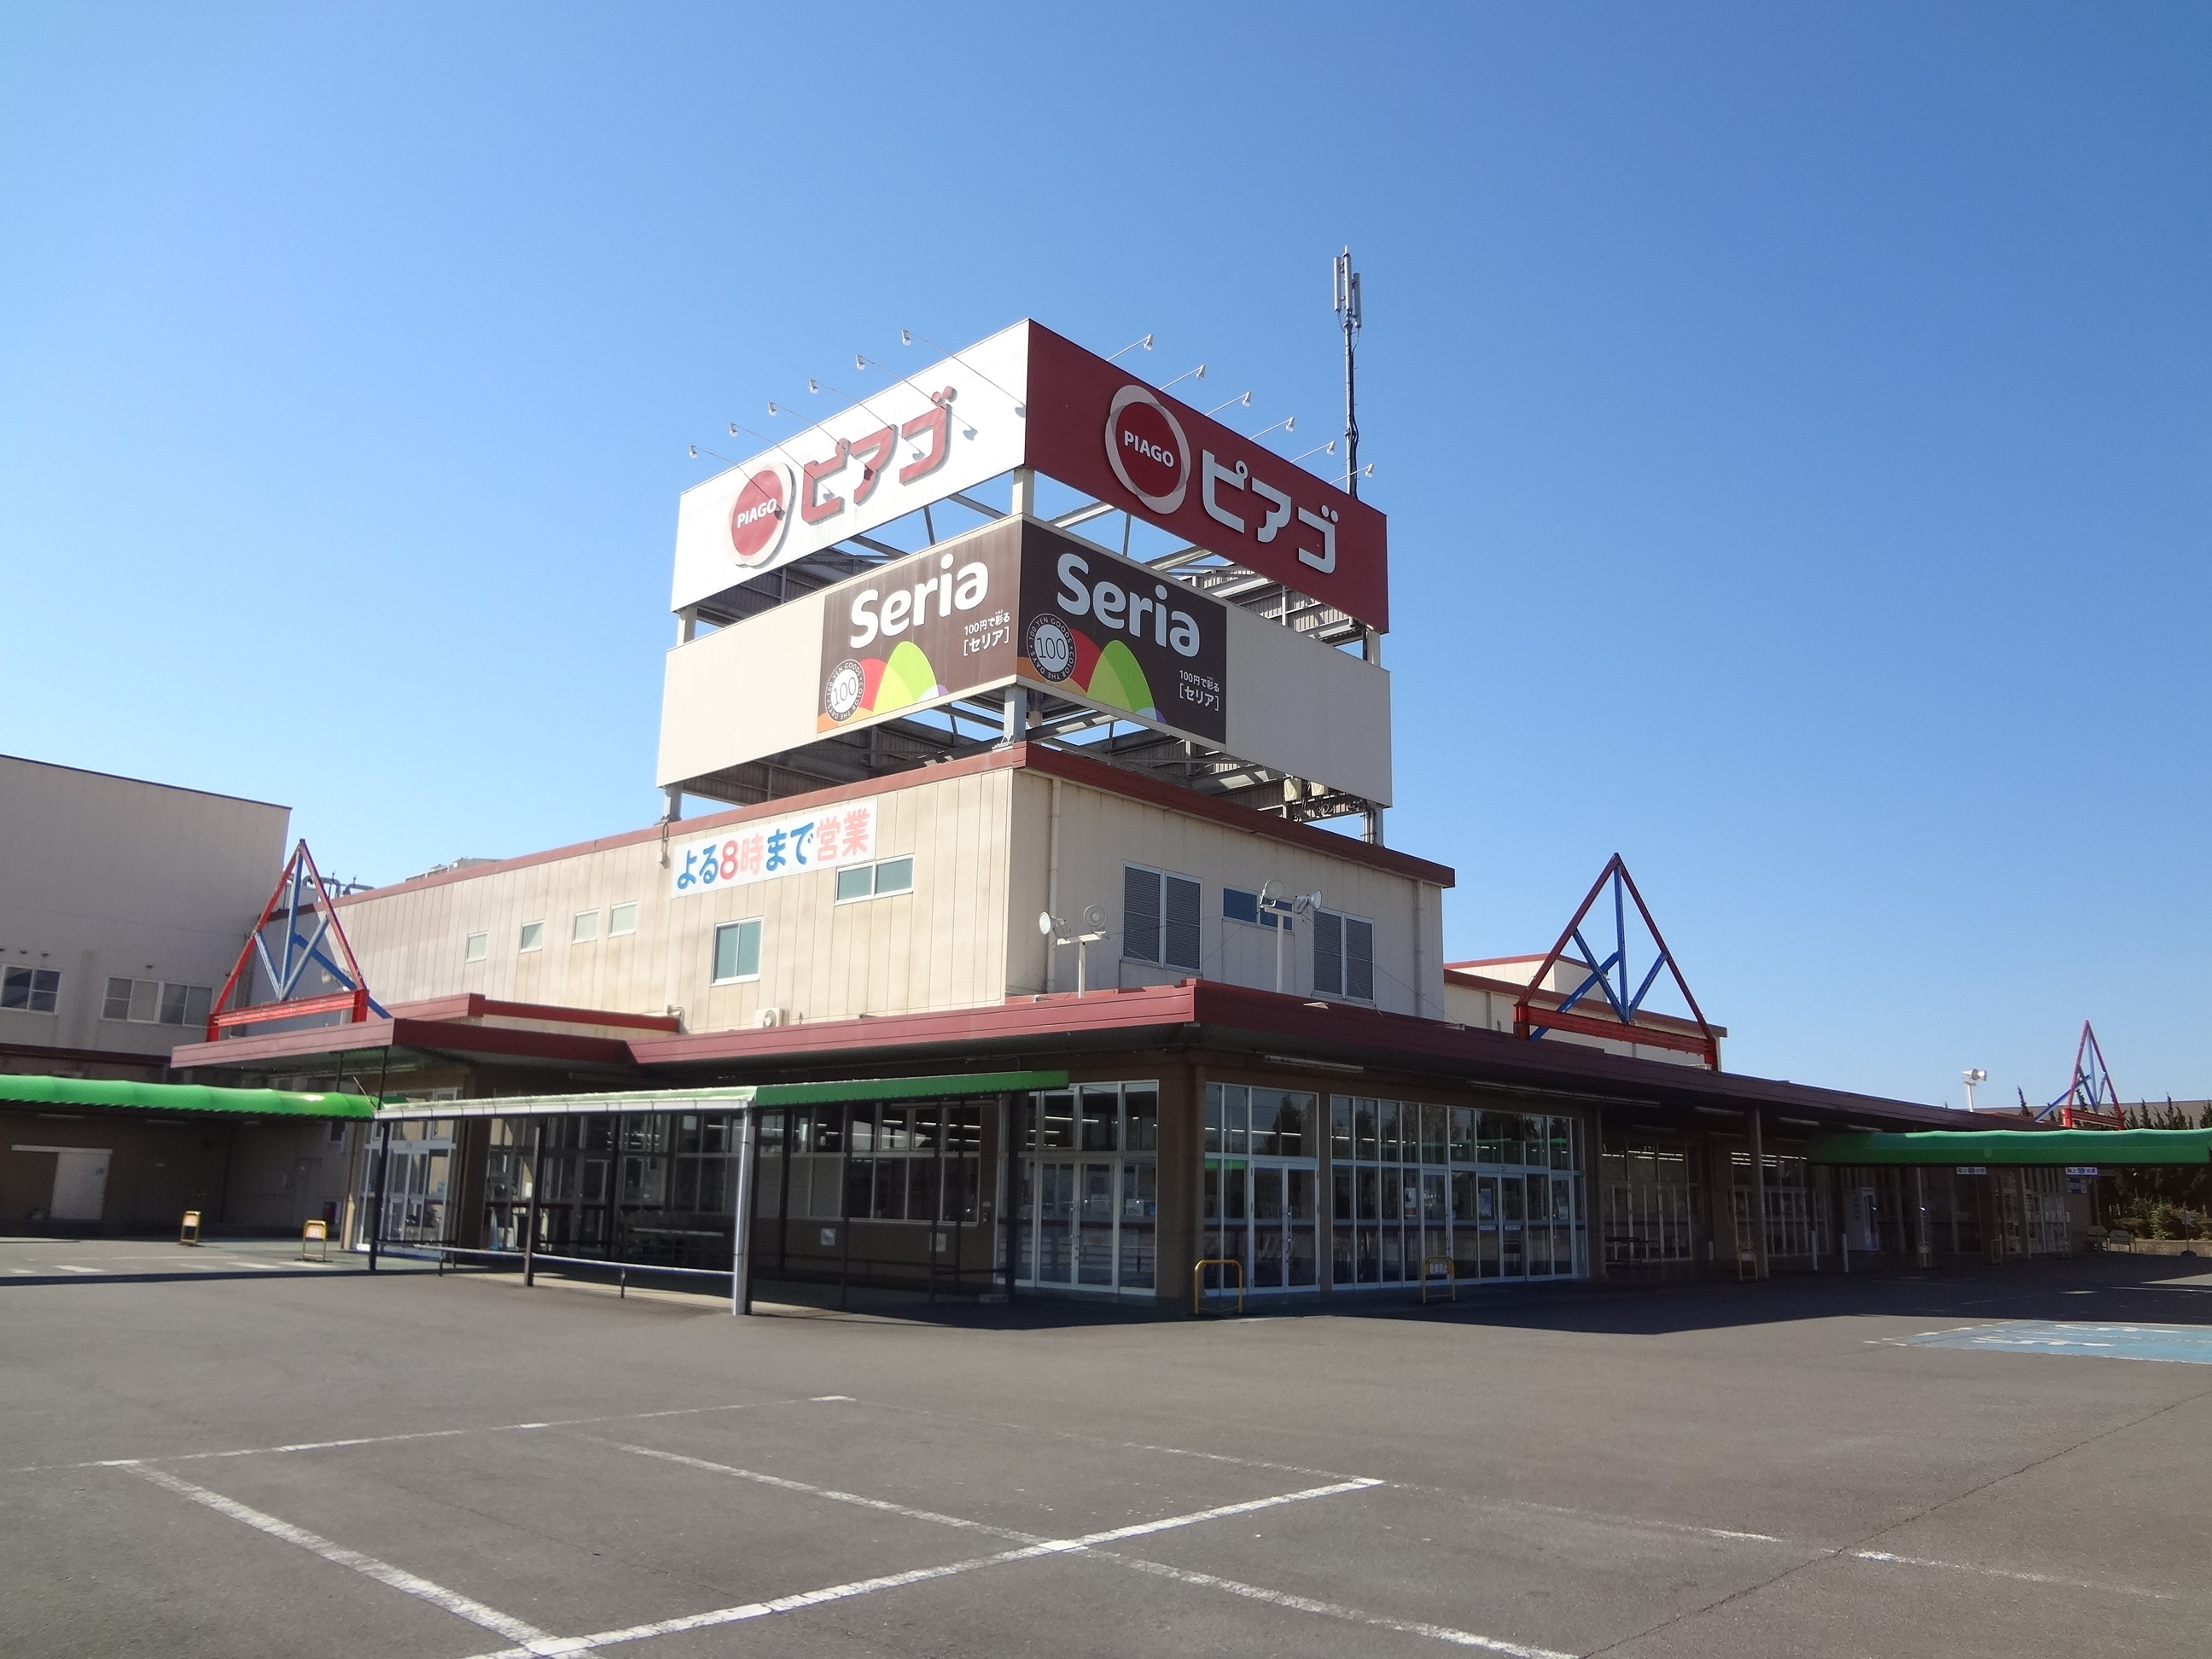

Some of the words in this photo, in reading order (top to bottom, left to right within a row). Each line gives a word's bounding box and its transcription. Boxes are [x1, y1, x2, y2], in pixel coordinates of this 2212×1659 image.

[801, 386, 957, 526] ピアゴ
[1124, 429, 1175, 469] PIAGO
[736, 498, 777, 528] PIAGO
[1202, 449, 1339, 574] ピアゴ
[850, 552, 990, 649] Seria
[1057, 552, 1201, 658] Seria
[963, 611, 1010, 636] 100円で彩る
[1035, 617, 1049, 626] YEN
[1051, 618, 1073, 643] GOODS
[1030, 651, 1045, 674] DAYS
[1037, 637, 1066, 660] 100
[1061, 651, 1074, 678] COLOR
[833, 677, 857, 707] 100
[1179, 670, 1220, 693] 100円で彩る
[677, 807, 870, 890] よる8時まで営業
